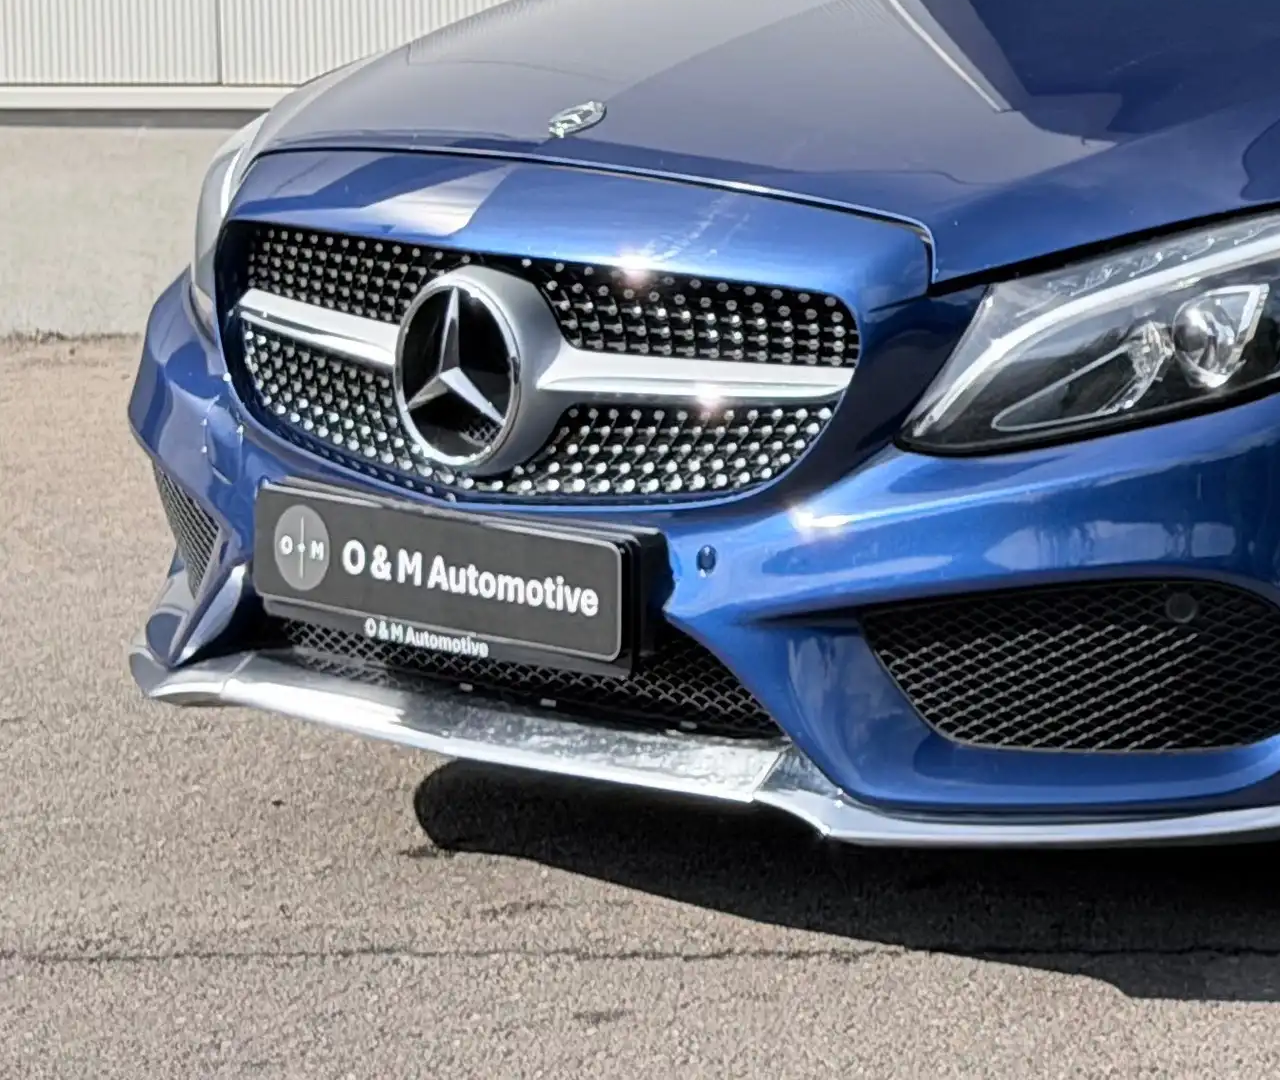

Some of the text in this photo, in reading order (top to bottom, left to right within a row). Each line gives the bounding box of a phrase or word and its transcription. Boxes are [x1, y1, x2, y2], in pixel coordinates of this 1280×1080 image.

[280, 535, 325, 561] O M
[342, 539, 599, 617] O & M Automotive
[364, 617, 489, 658] O & M Automotive
